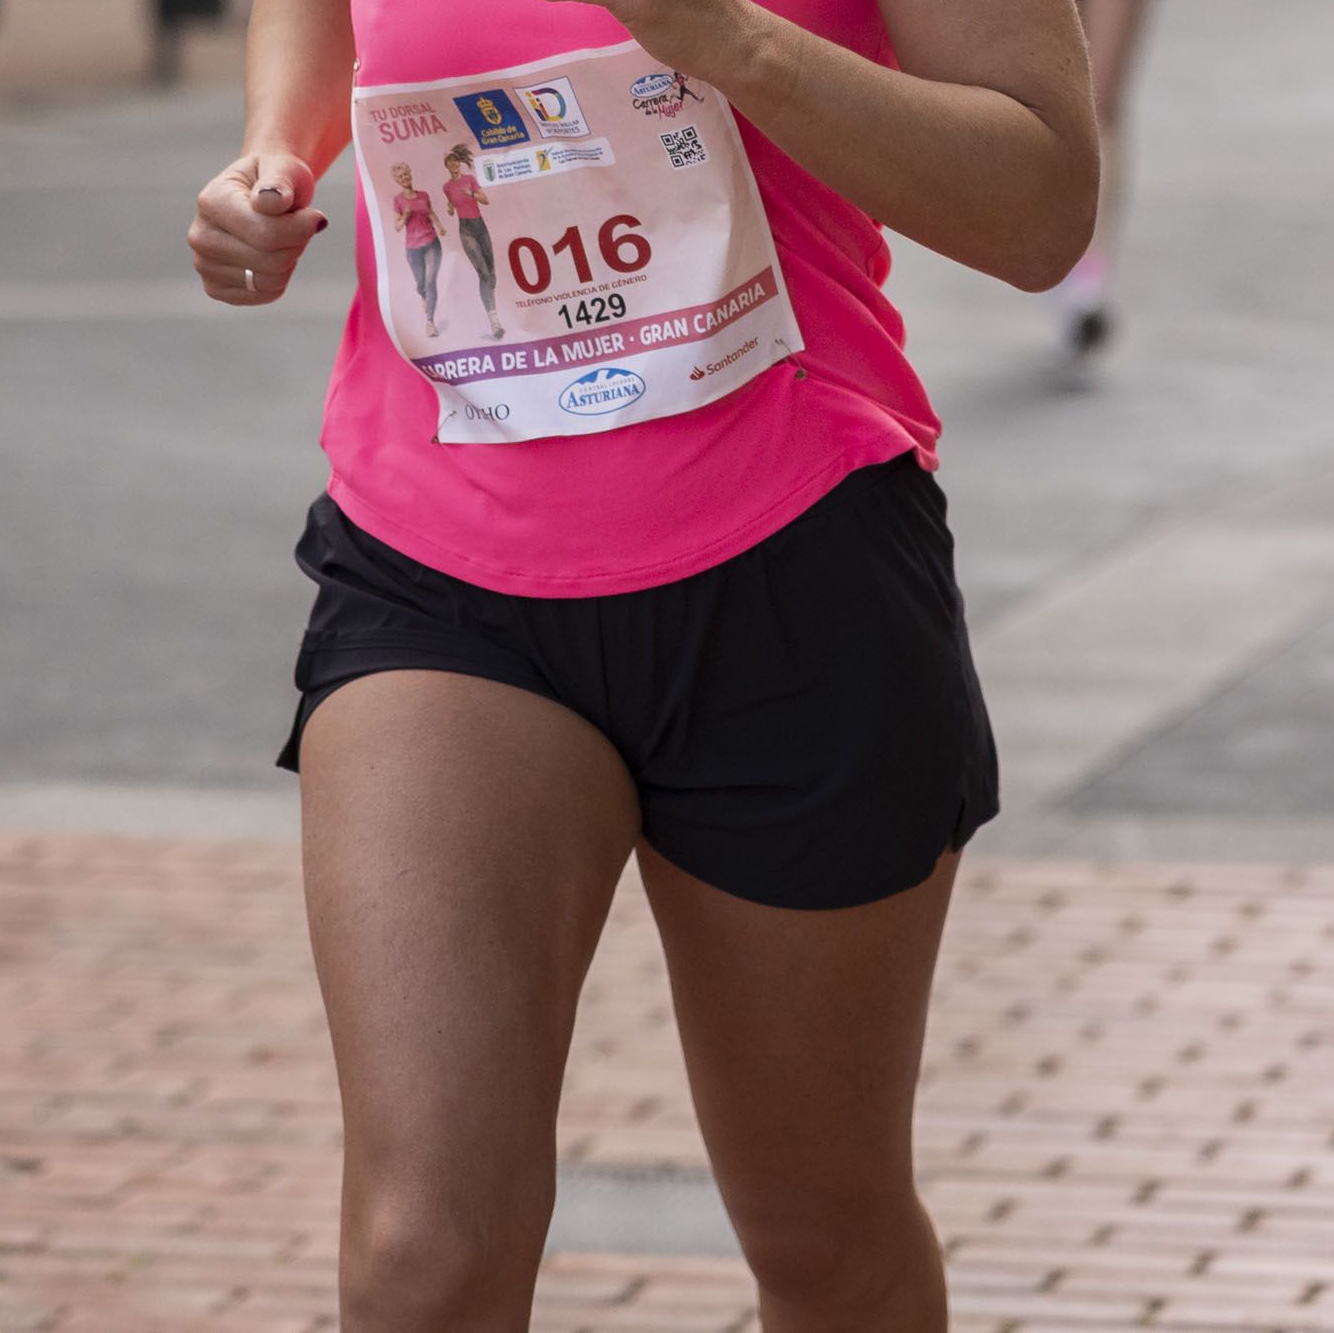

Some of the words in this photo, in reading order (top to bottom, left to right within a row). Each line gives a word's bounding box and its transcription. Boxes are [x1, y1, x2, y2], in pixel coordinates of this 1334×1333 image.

[369, 109, 387, 122] TU
[389, 102, 436, 119] DORSAL
[632, 95, 670, 109] Carrera
[379, 114, 447, 144] SUMA
[508, 214, 652, 295] 016
[515, 296, 553, 308] TELÉFONO
[554, 287, 597, 302] VIOLENCIA
[599, 283, 611, 294] DE
[611, 274, 648, 289] GÉNERO
[501, 351, 528, 371] DE
[533, 346, 559, 367] LA
[562, 335, 624, 363] MUJER
[639, 319, 688, 346] GRAN
[693, 282, 765, 333] CANARIA
[558, 293, 627, 329] 1429
[706, 336, 759, 376] Santander
[567, 383, 640, 409] ASTURIANA
